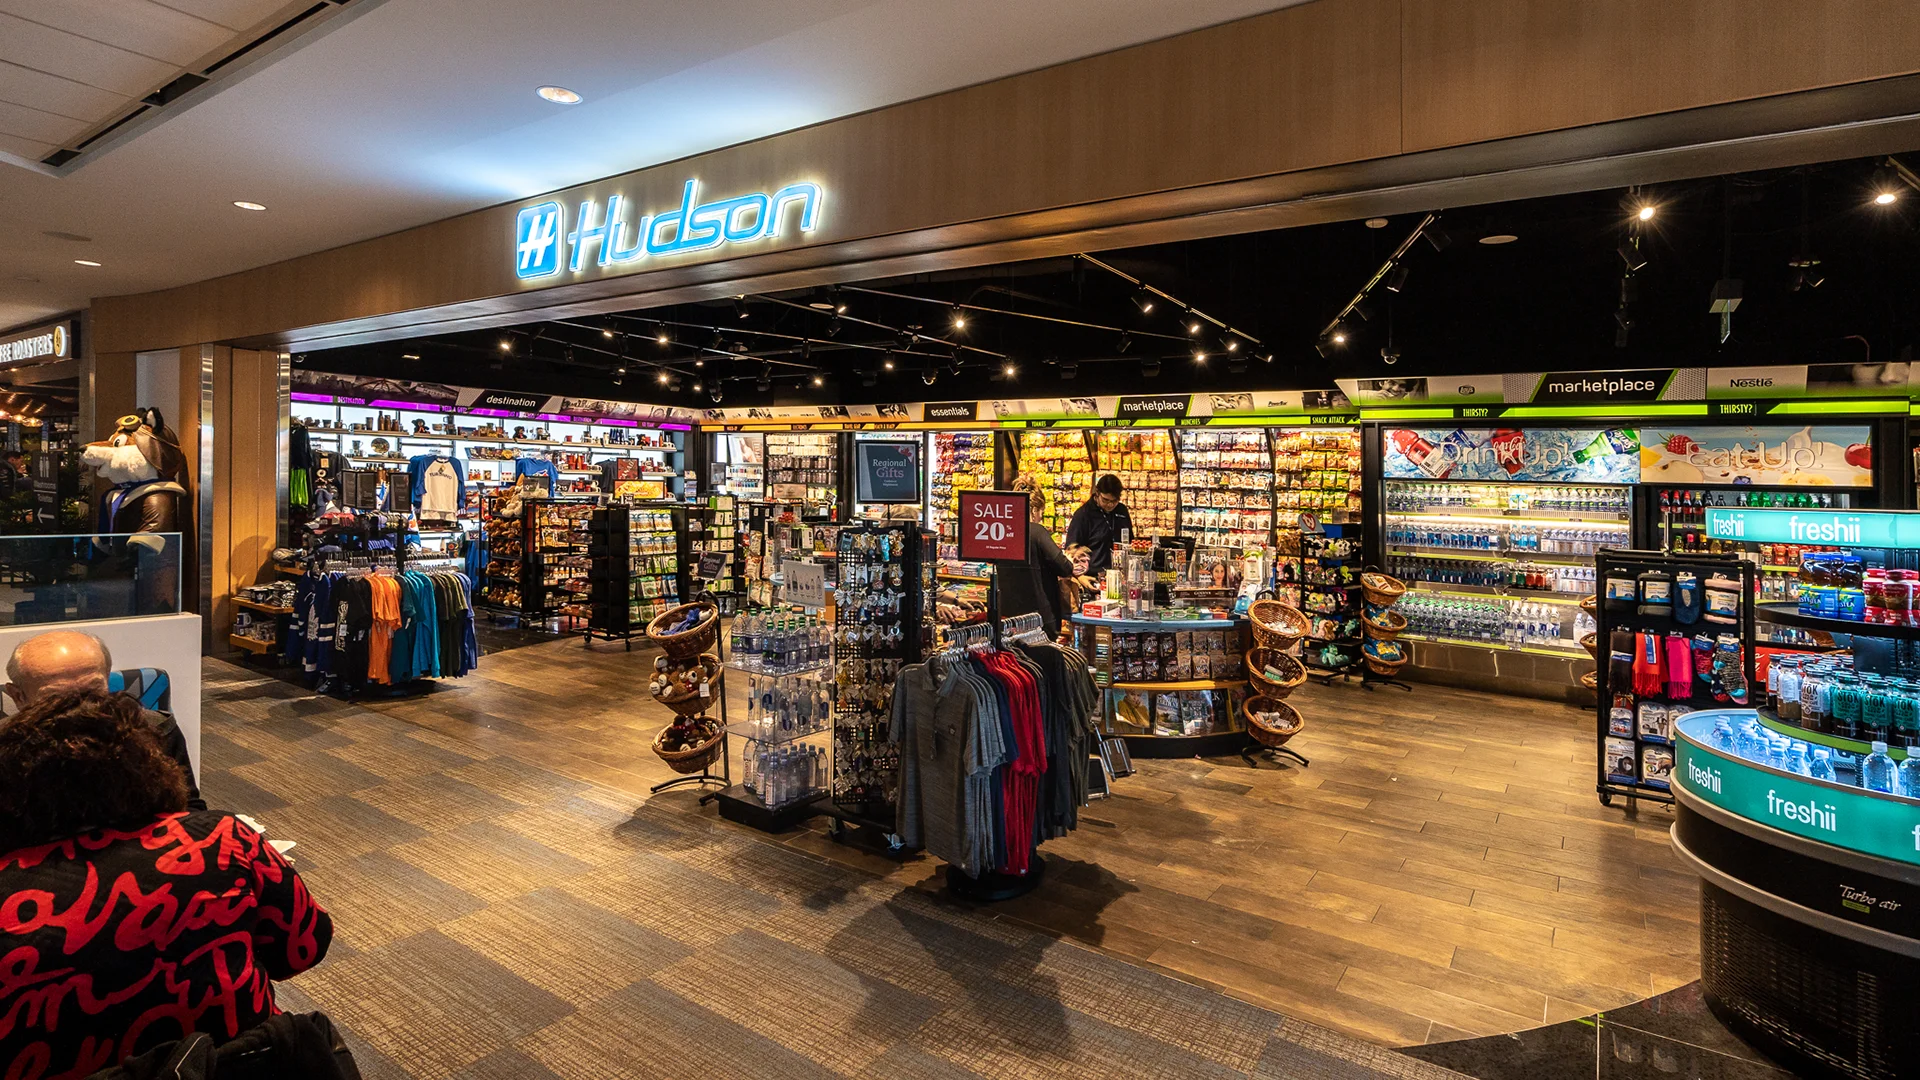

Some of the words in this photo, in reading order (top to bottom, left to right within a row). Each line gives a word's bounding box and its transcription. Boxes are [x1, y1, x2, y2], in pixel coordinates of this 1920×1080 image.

[567, 178, 822, 272] Hudson
[12, 333, 54, 360] ROASTERS
[1548, 378, 1656, 395] marketplace
[486, 395, 536, 408] destination
[1123, 400, 1185, 415] marketplace
[1719, 403, 1753, 414] THIRSTY?
[931, 407, 970, 417] essentials
[1312, 417, 1328, 425] SNACK
[1328, 416, 1346, 425] ATTACK
[1462, 408, 1489, 418] THIRSTY?
[1440, 440, 1518, 465] Drink
[1685, 441, 1746, 469] Eat
[1758, 441, 1824, 475] Up!
[872, 458, 907, 468] Regional
[876, 466, 905, 479] Gifts
[973, 502, 1014, 519] SALE
[974, 521, 1006, 541] 20
[1713, 513, 1744, 537] freshii
[1789, 515, 1861, 543] freshii
[1688, 758, 1722, 795] freshii
[1767, 789, 1837, 832] freshii
[1840, 884, 1877, 905] Turbo
[1879, 900, 1902, 911] air
